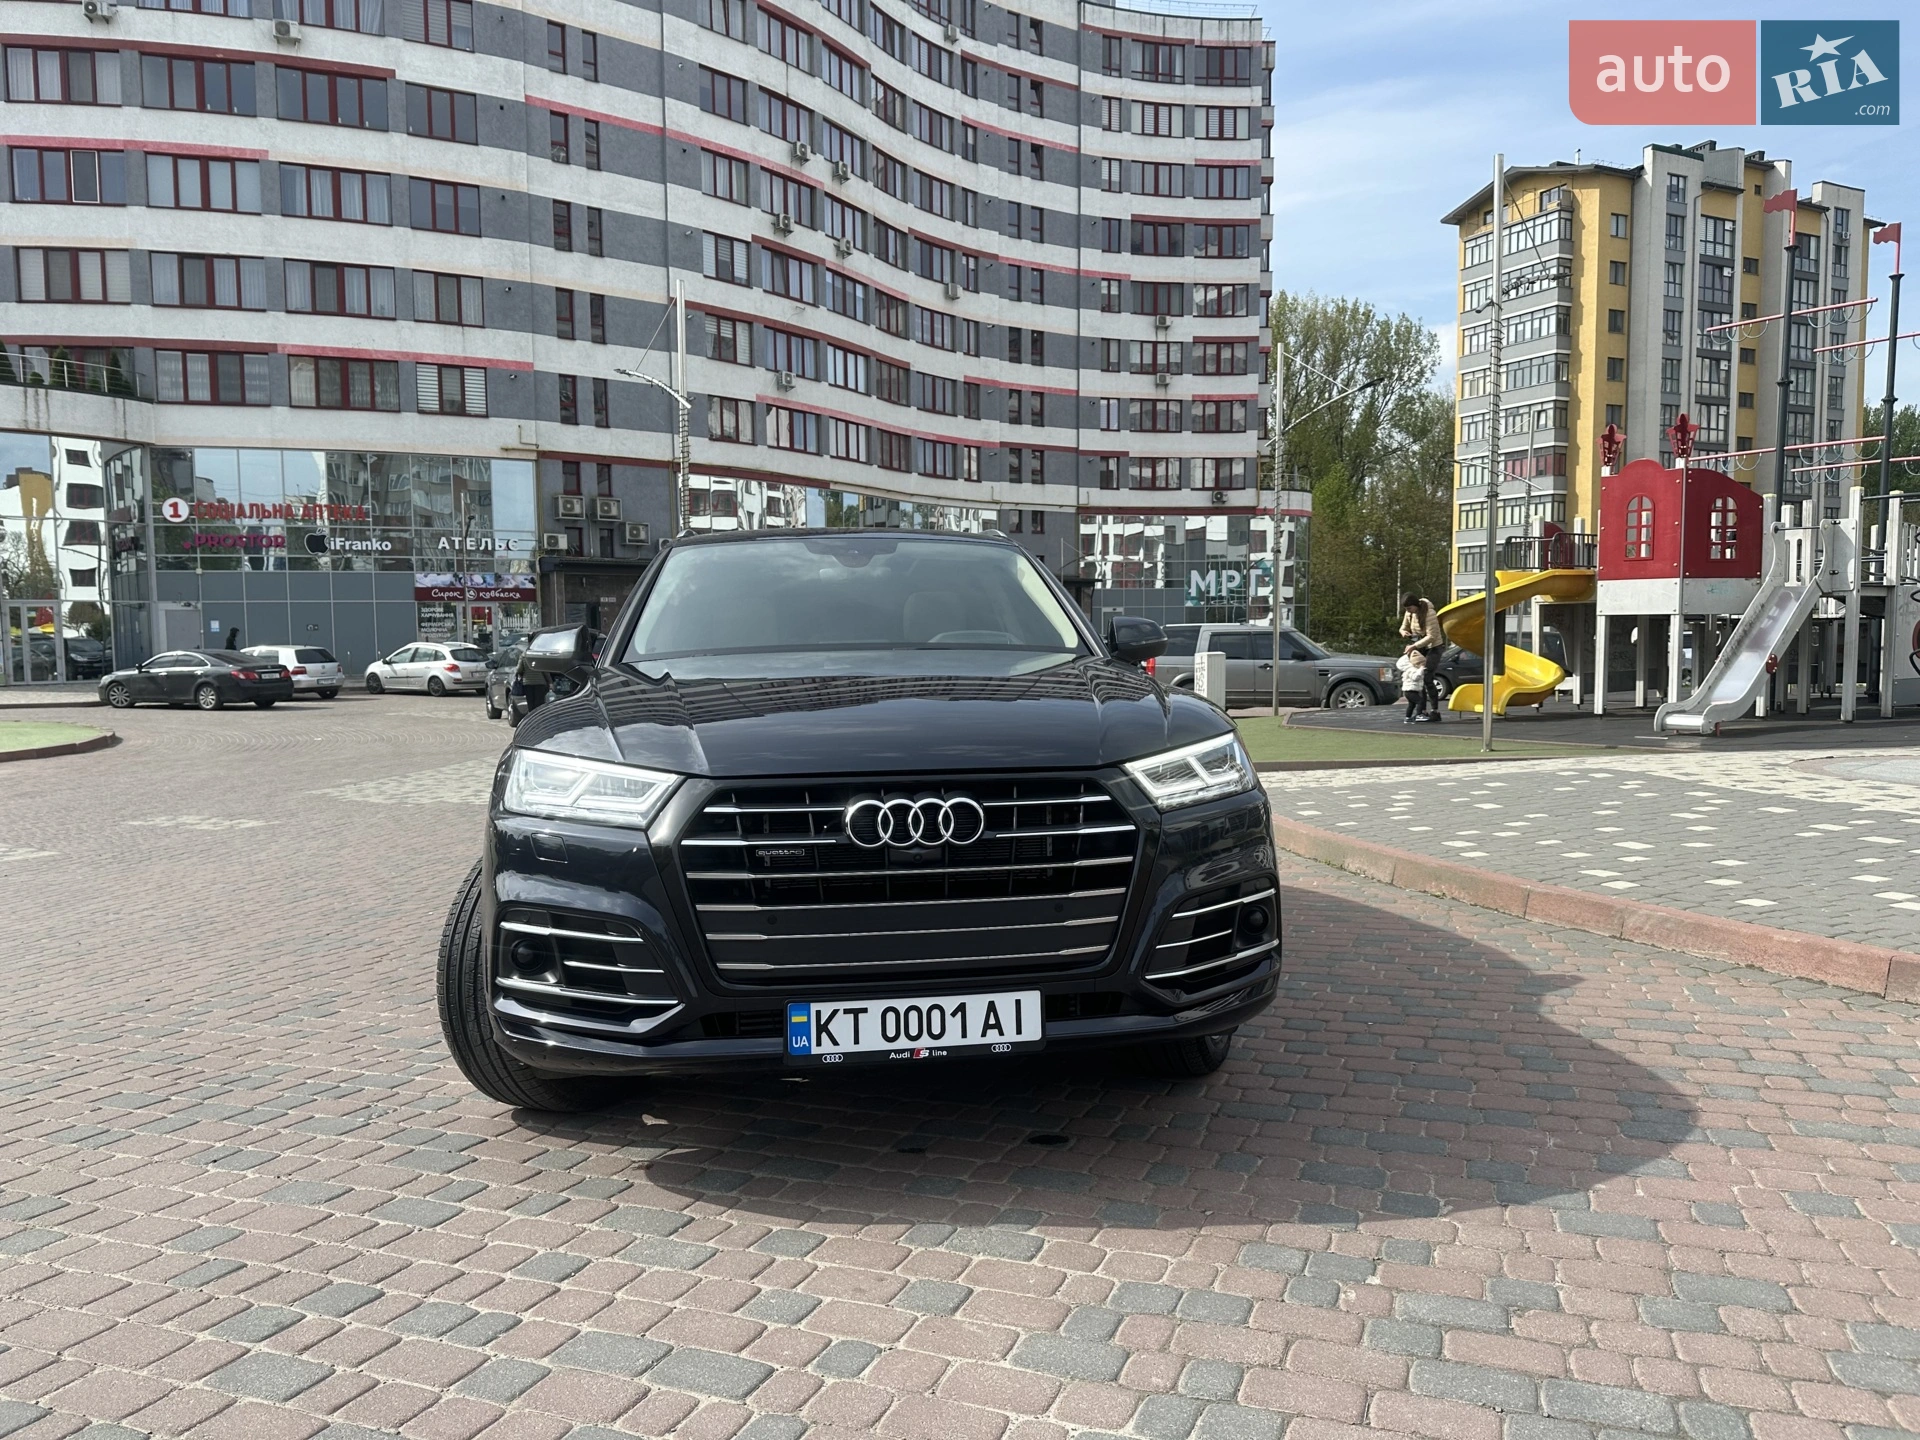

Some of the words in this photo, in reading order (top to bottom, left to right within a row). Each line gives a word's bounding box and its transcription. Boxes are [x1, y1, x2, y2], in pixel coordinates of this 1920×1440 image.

[195, 502, 295, 521] СОЦІАЛЬНА
[301, 504, 366, 521] АПТЕКА
[195, 534, 285, 549] PROSTOR
[329, 538, 392, 551] iFranko
[438, 536, 519, 551] АТЕЛЬЄ
[431, 588, 464, 601] Сирок
[479, 588, 521, 600] ковбаска
[815, 1007, 868, 1048] KT
[881, 1002, 968, 1043] 0001
[981, 998, 1022, 1038] AI
[793, 1036, 809, 1048] UA
[889, 1051, 911, 1060] Audi
[932, 1050, 948, 1058] line
